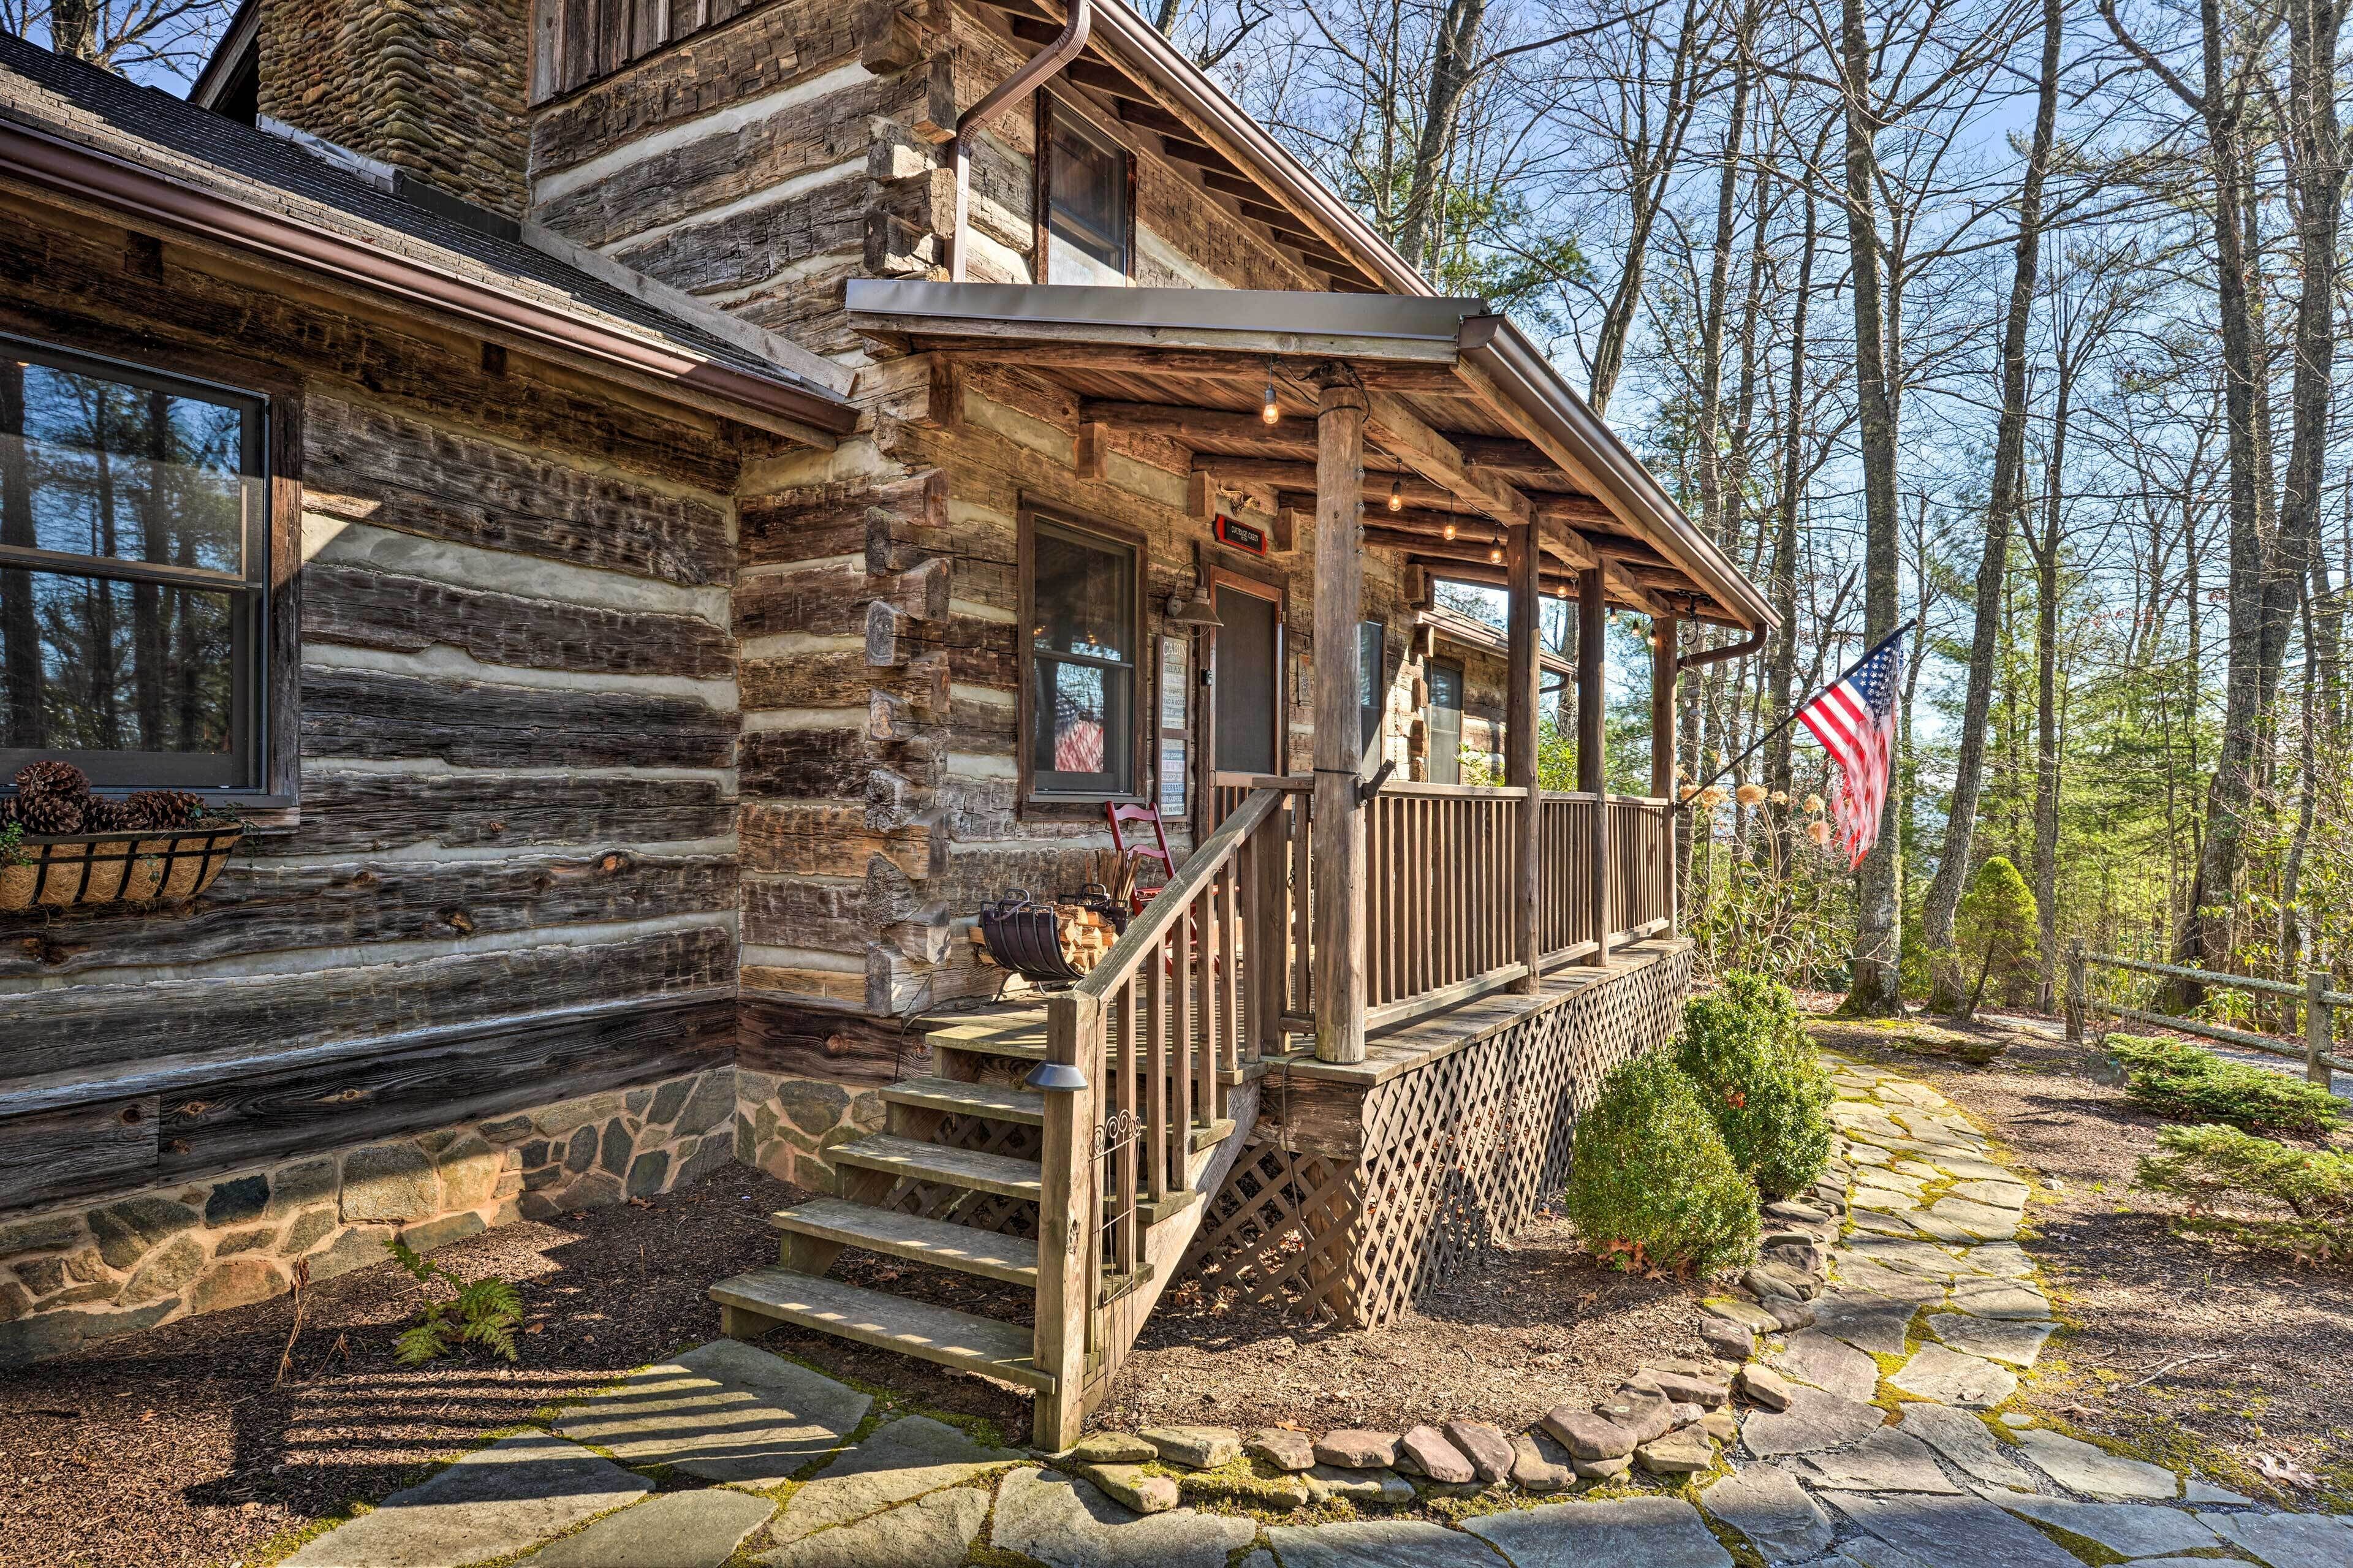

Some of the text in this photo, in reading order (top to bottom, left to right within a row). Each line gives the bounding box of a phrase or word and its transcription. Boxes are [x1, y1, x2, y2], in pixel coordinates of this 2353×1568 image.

[1231, 526, 1248, 538] COURAGE
[1248, 532, 1259, 542] CABIN
[1163, 642, 1187, 659] CABIN
[1165, 665, 1181, 674] RELAX
